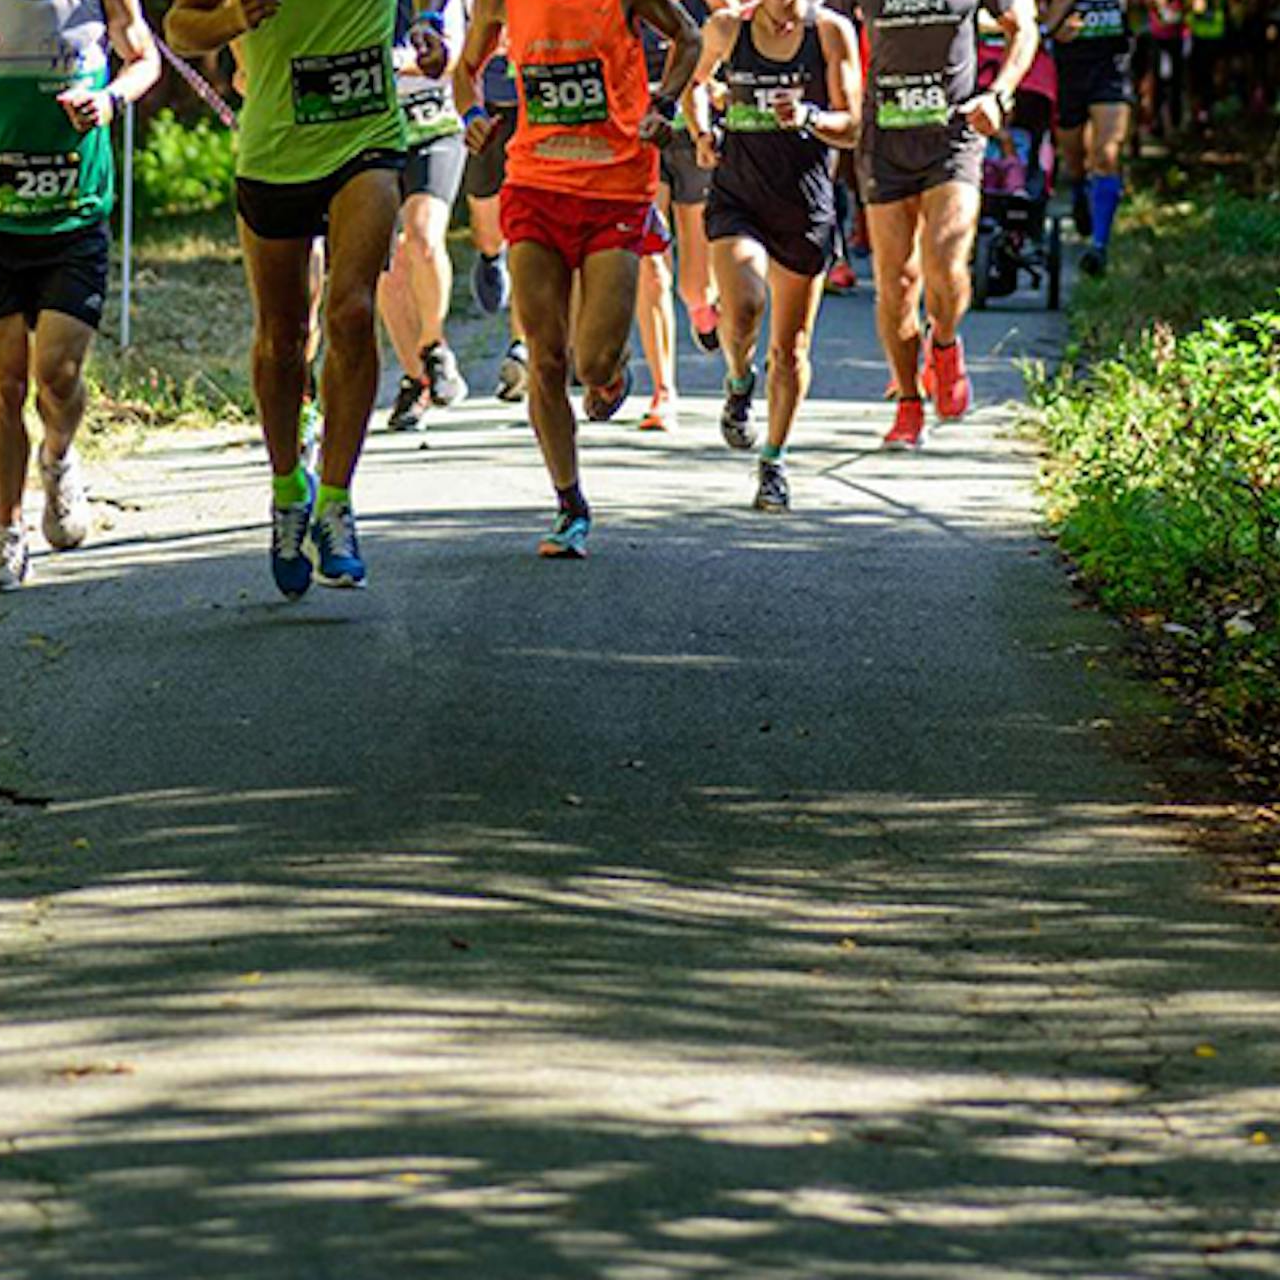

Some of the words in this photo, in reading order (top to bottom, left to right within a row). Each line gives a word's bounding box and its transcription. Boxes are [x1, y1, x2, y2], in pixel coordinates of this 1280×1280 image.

[329, 63, 383, 104] 321
[539, 78, 604, 109] 303
[895, 85, 947, 111] 168
[16, 167, 79, 199] 287
